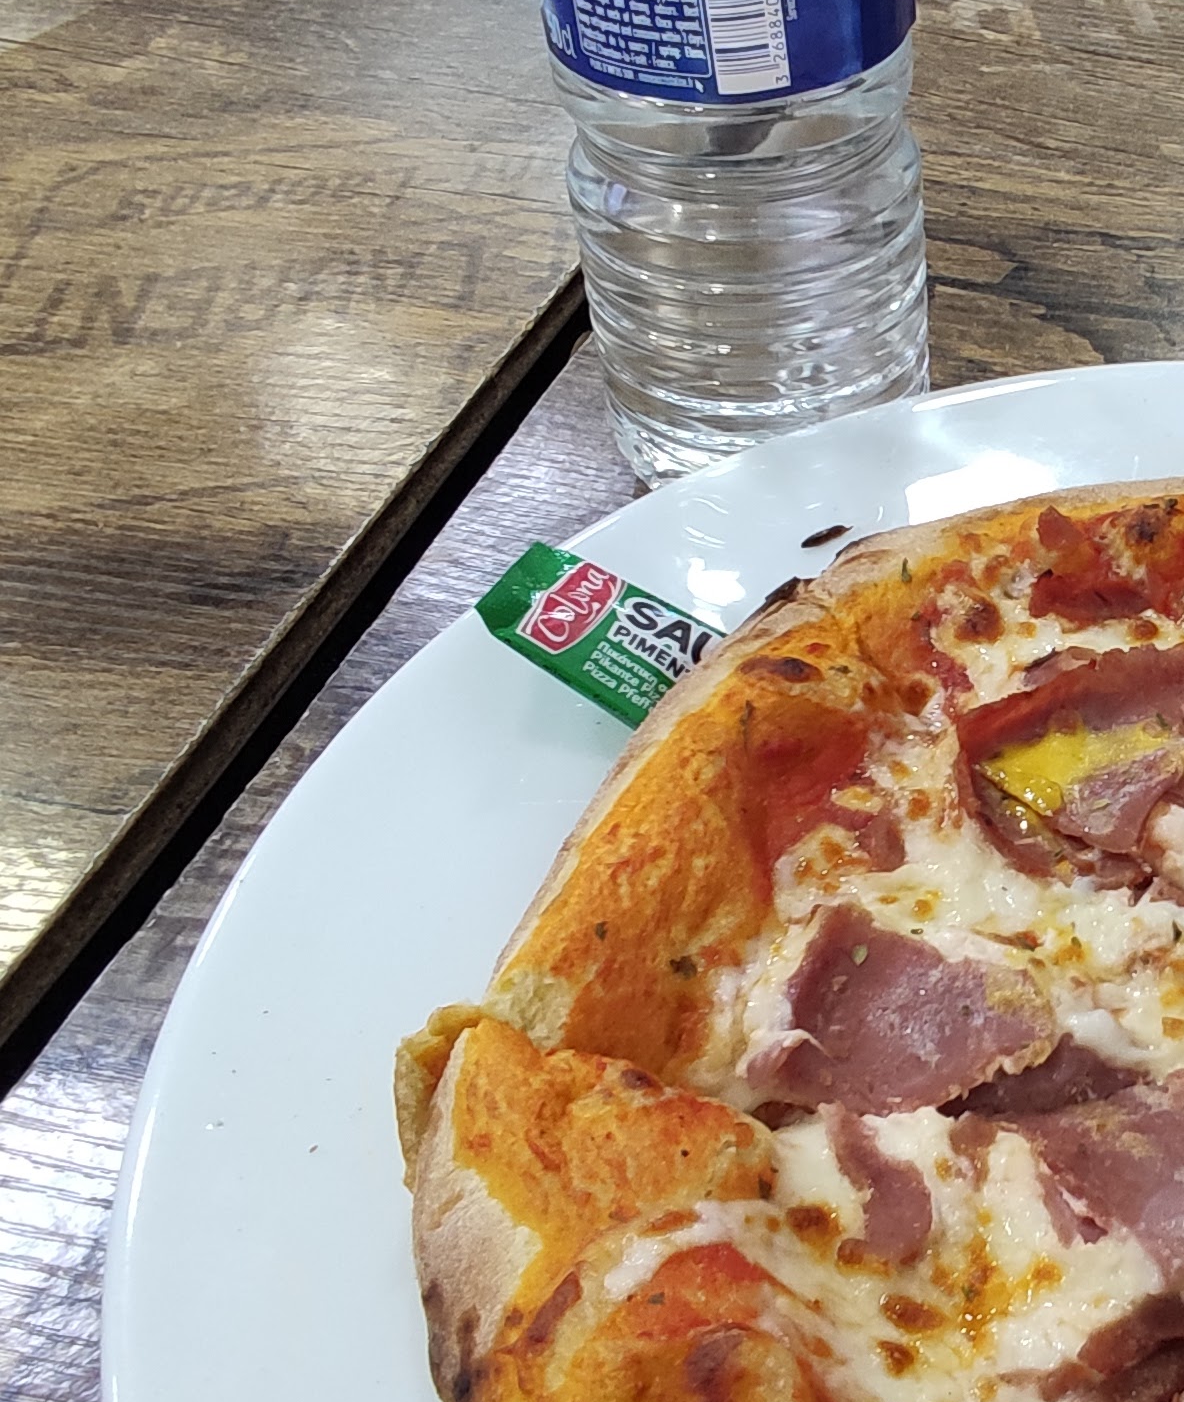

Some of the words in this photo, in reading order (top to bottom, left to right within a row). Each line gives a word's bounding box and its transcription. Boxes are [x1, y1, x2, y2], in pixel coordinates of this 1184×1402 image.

[613, 624, 691, 679] PIMEN
[583, 660, 618, 689] Pizza
[618, 683, 654, 713] Pfeff
[642, 680, 661, 703] Piz
